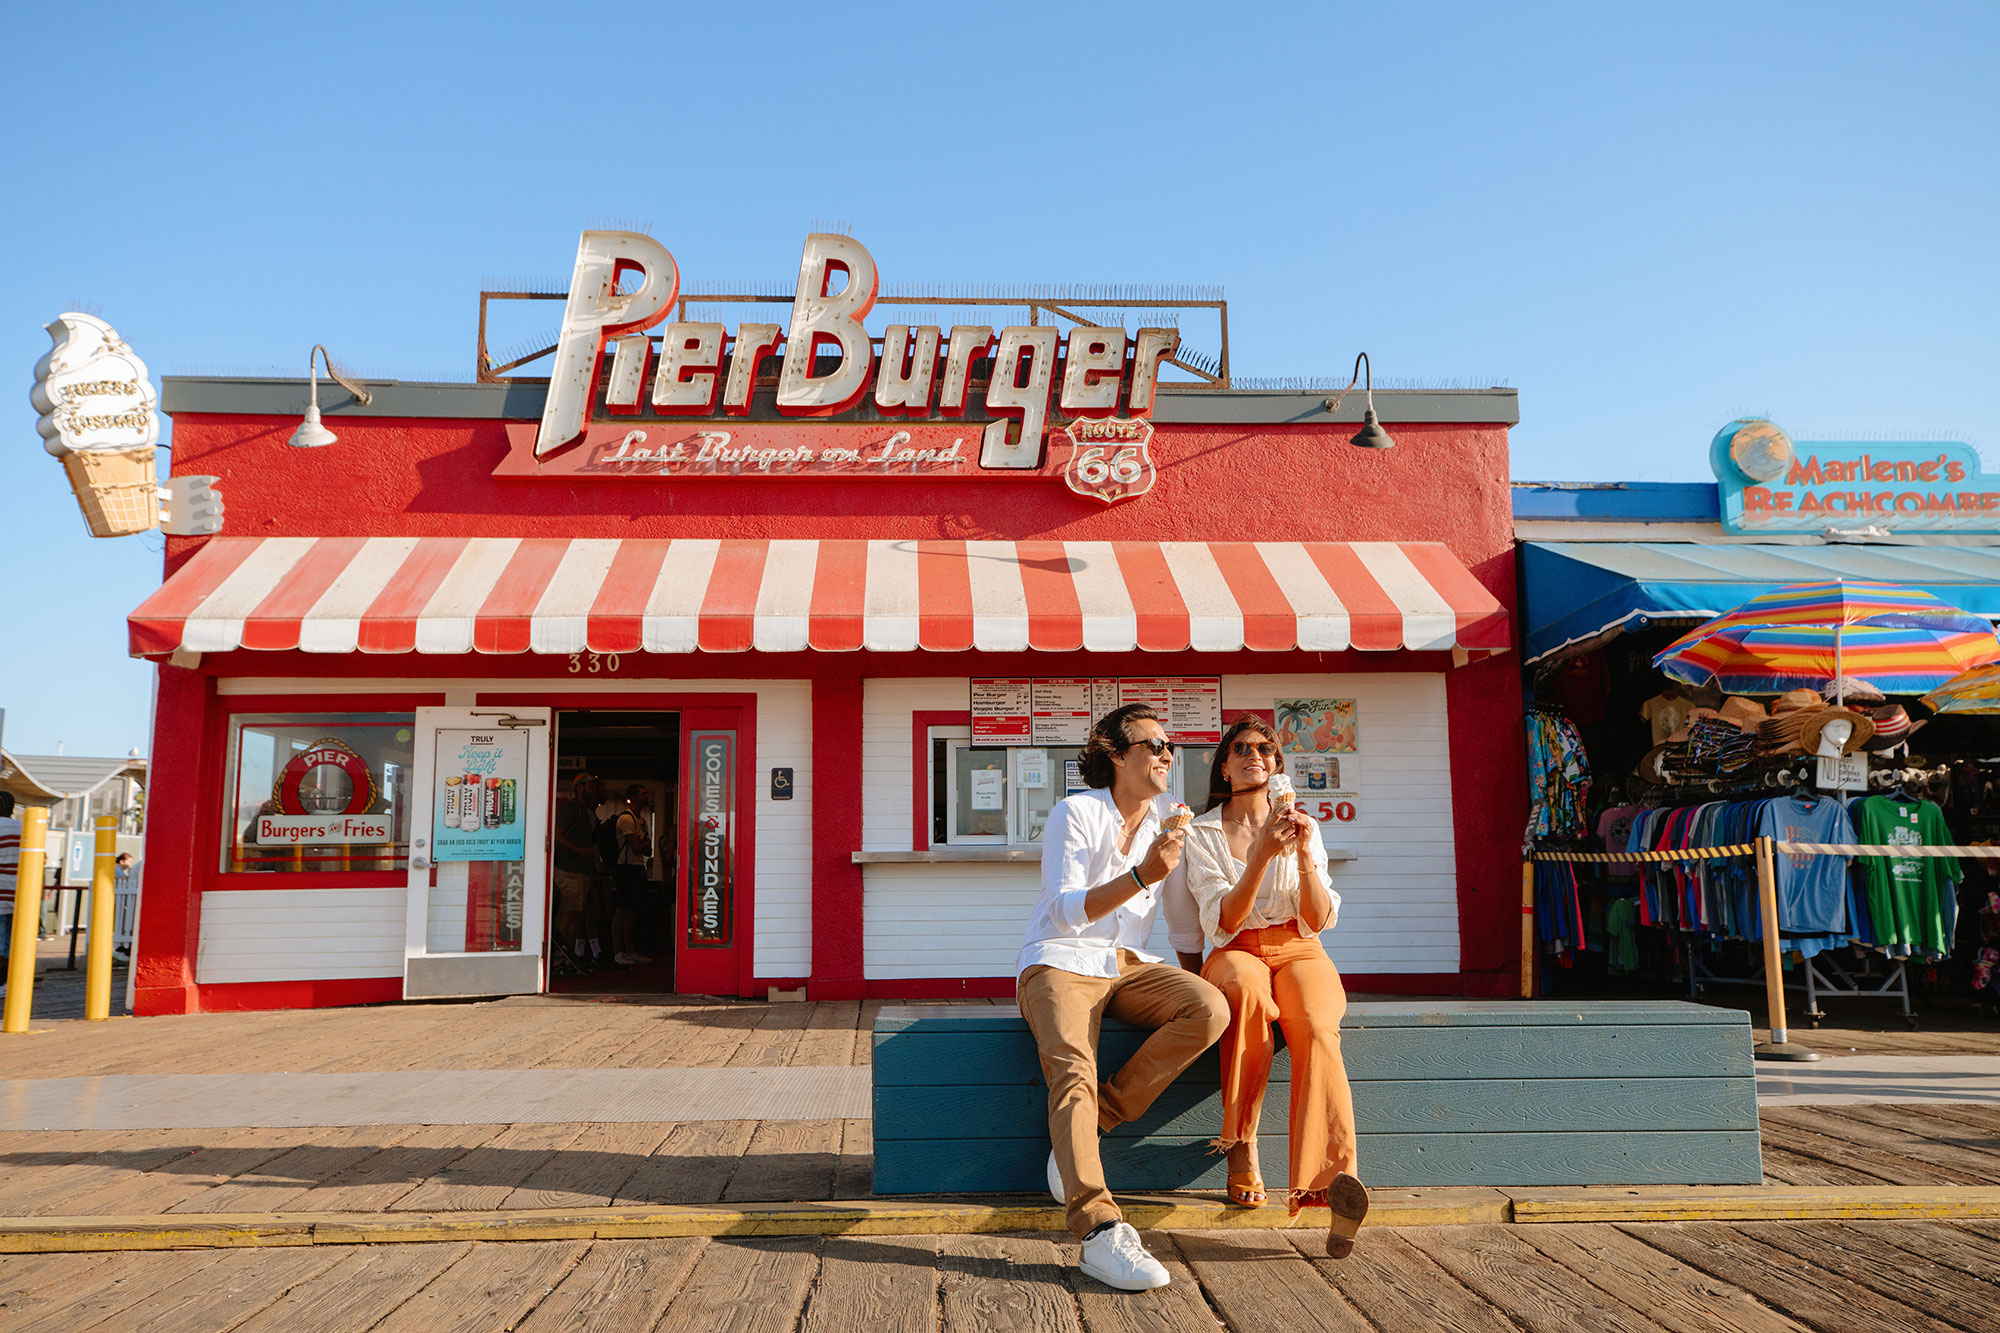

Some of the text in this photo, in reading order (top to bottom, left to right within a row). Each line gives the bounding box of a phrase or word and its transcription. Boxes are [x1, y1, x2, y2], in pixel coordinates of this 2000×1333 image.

[535, 229, 1180, 470] Pier Burger
[1081, 423, 1138, 439] ROUTE
[602, 430, 688, 464] Last
[820, 447, 862, 463] on
[866, 430, 967, 464] Land
[1077, 447, 1142, 484] 66
[1785, 453, 1966, 486] Marlene's
[568, 653, 620, 673] 330
[470, 735, 494, 743] TRULY
[303, 751, 350, 767] PIER
[462, 757, 497, 774] Light
[447, 789, 455, 815] TRULY
[464, 788, 473, 817] TRULY
[486, 788, 495, 817] TRULY
[261, 819, 325, 842] Burgers
[344, 818, 385, 837] Fries
[703, 744, 721, 929] CONES & SUNDAES
